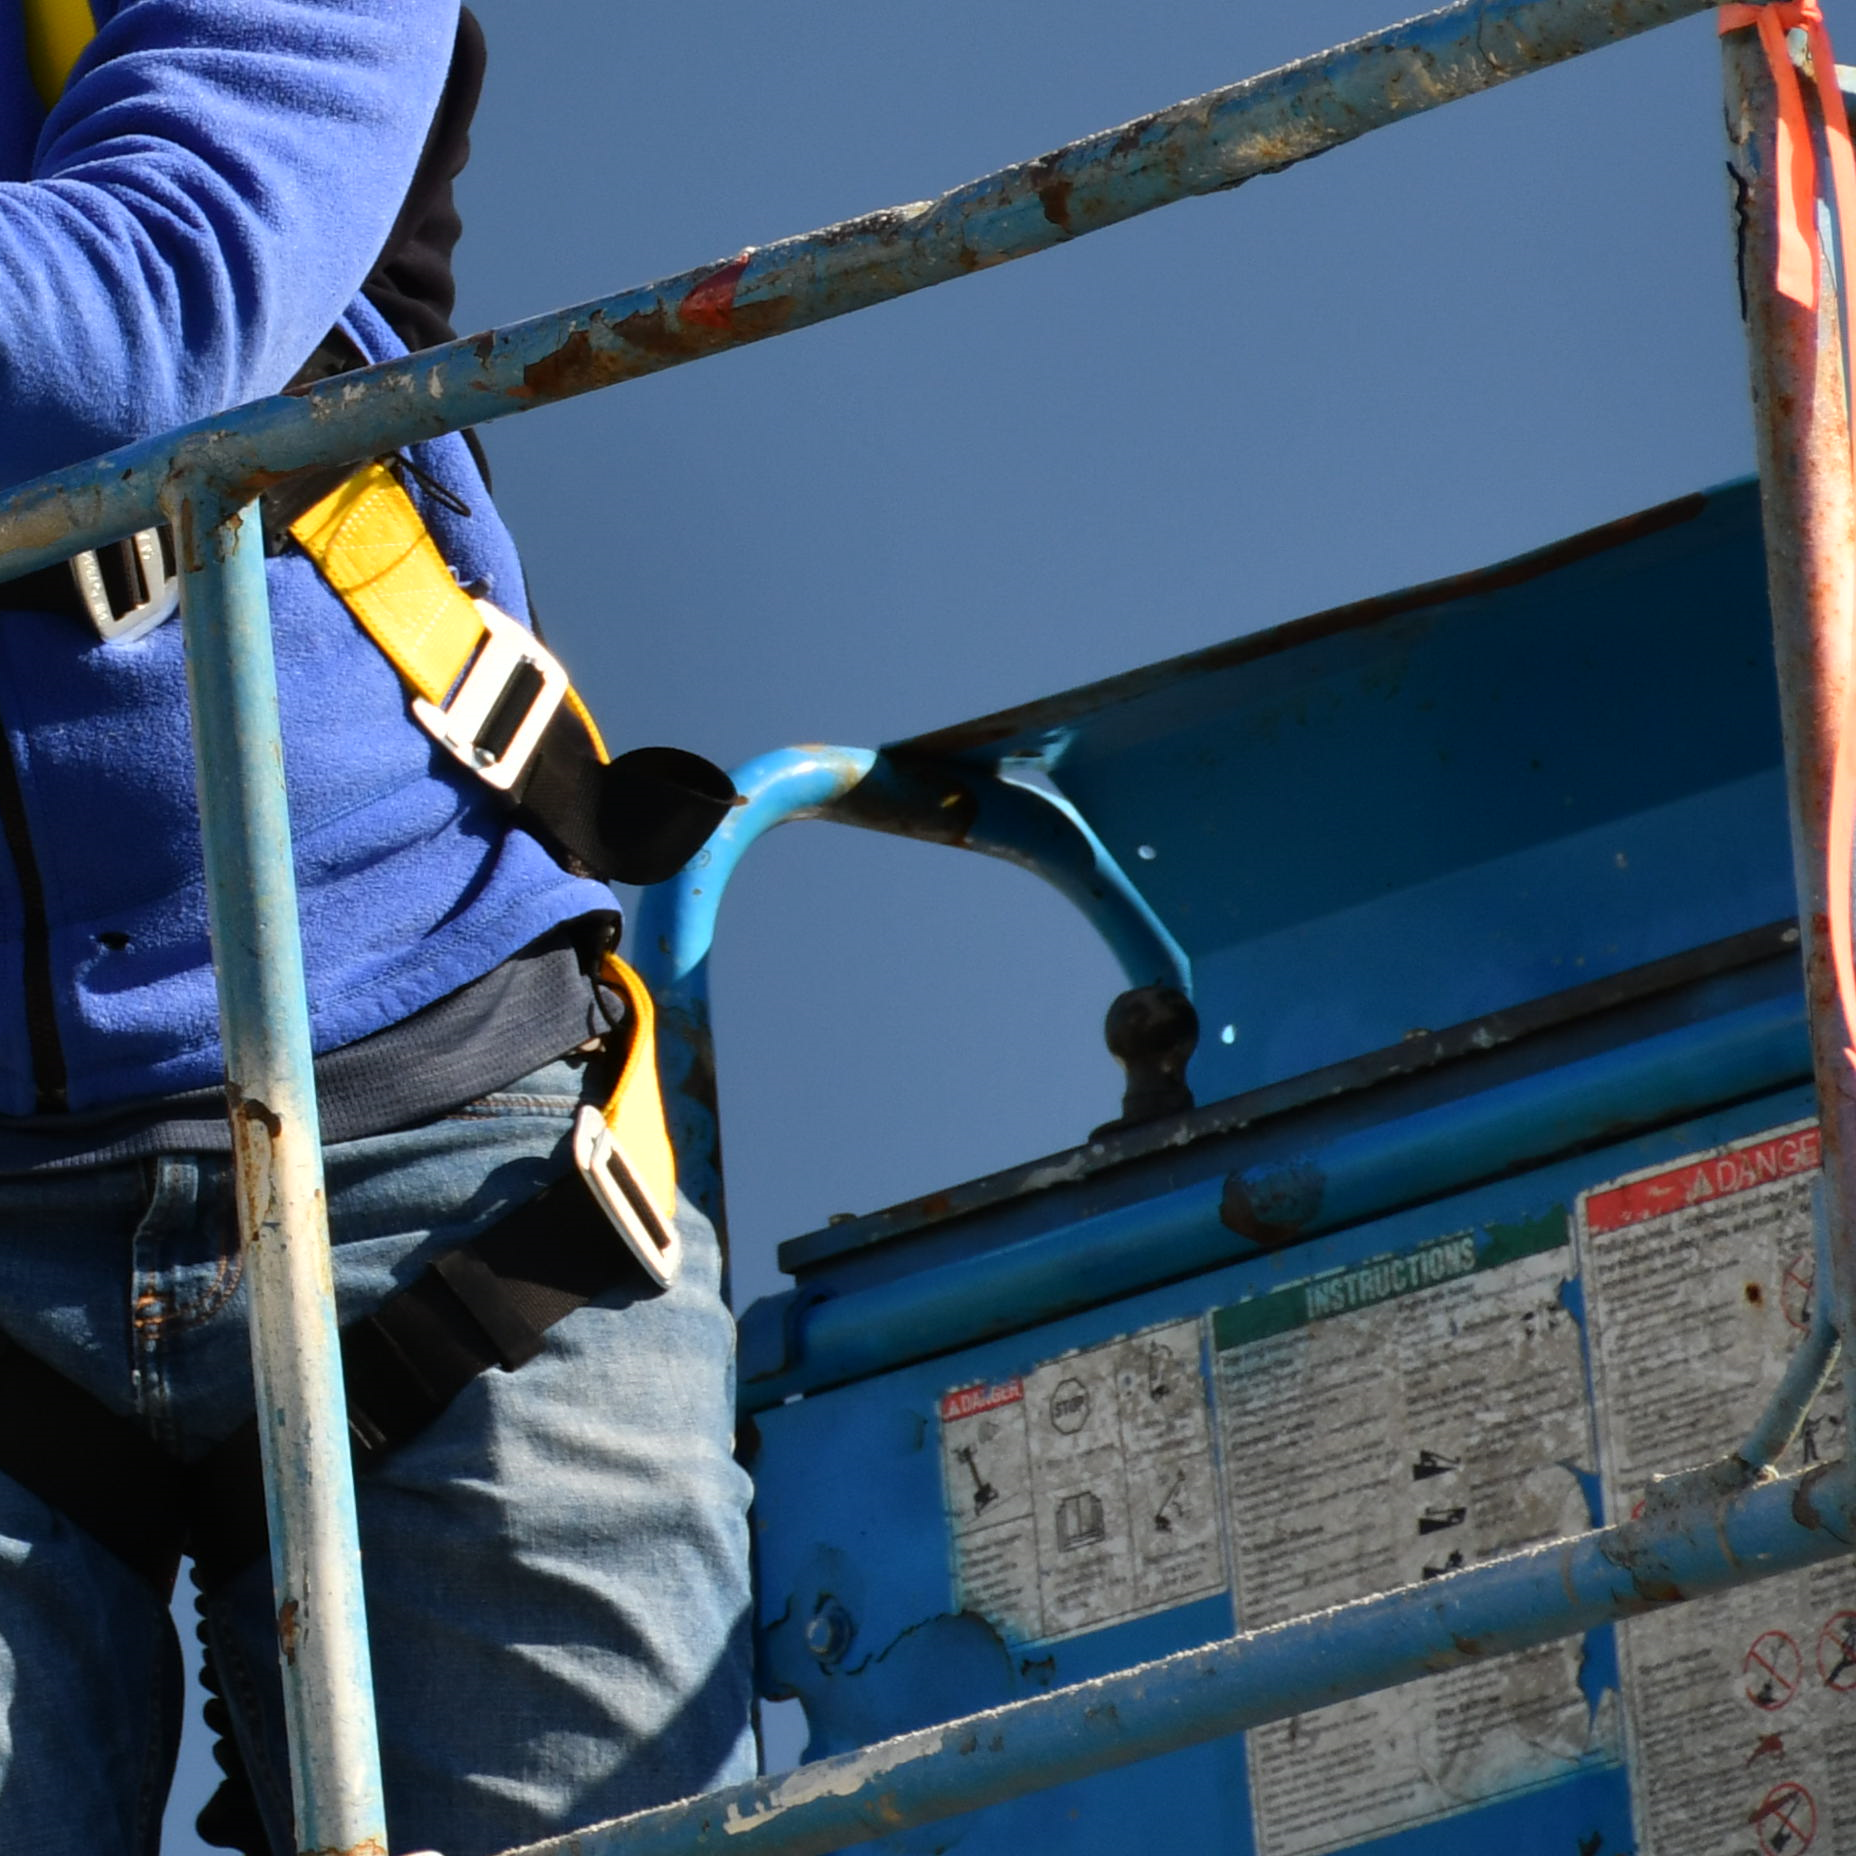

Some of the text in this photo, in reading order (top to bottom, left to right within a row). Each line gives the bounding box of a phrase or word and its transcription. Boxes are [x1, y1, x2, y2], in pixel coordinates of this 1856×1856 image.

[1716, 1132, 1822, 1193] DANGE
[1305, 1236, 1476, 1320] INSTRUCTIONS
[960, 1380, 1022, 1413] DAGER
